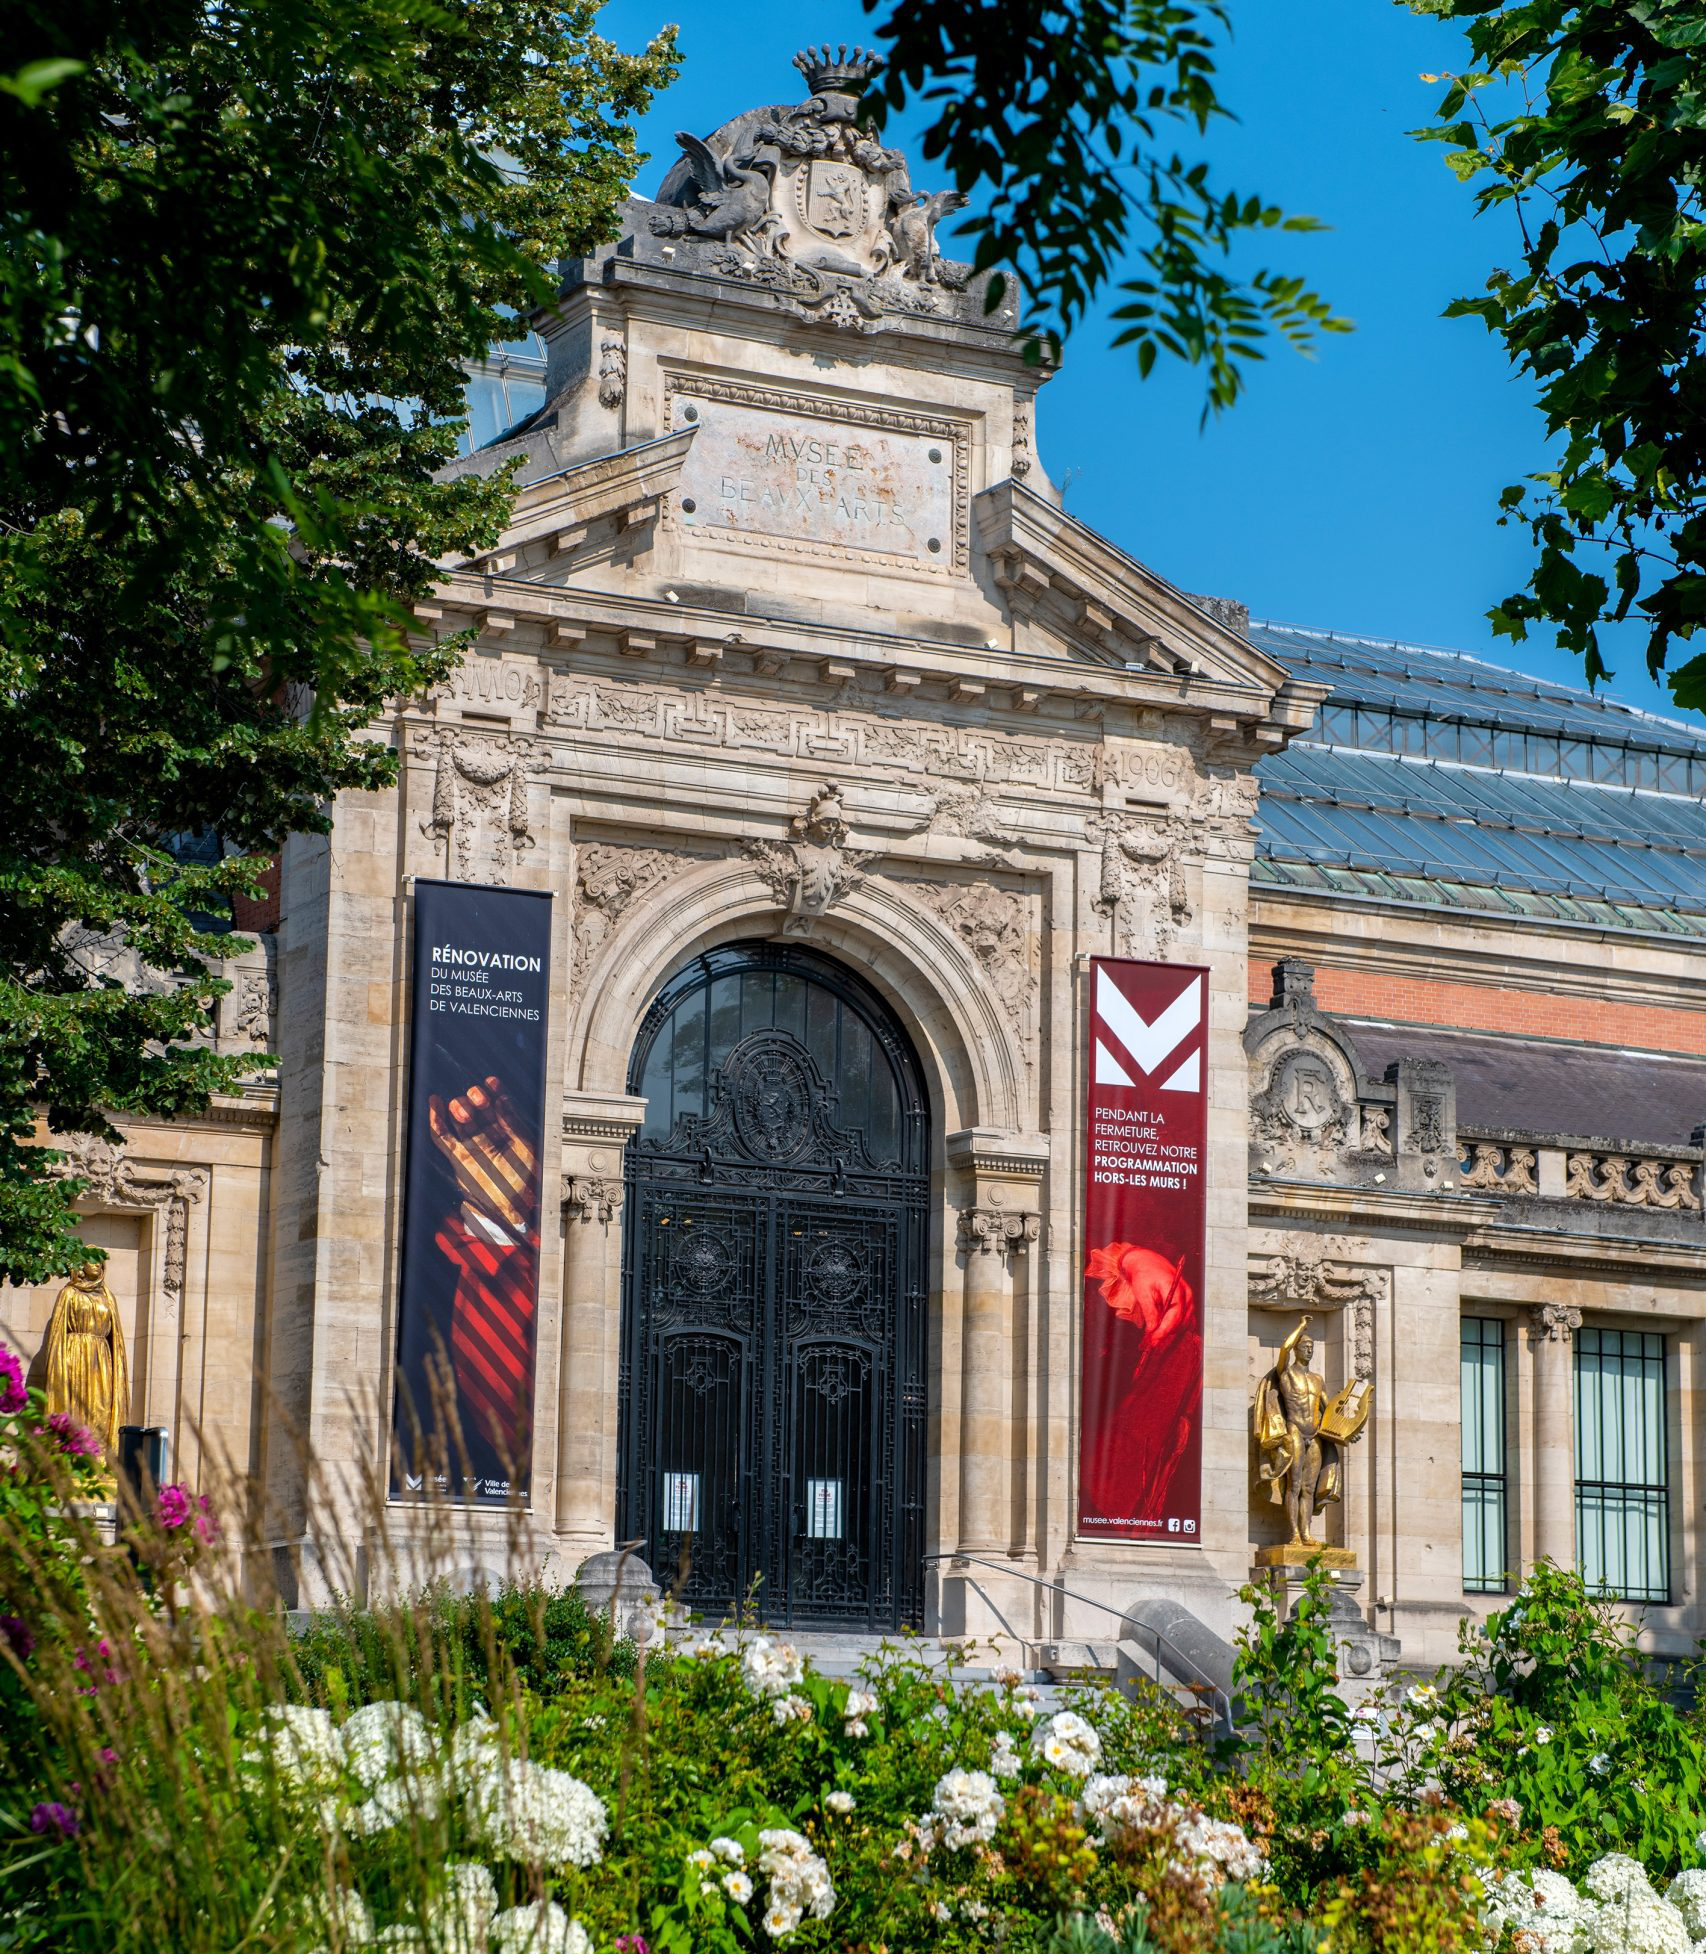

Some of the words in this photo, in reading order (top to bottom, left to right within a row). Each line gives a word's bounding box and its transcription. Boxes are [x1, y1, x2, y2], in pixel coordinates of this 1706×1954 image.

[796, 466, 832, 487] DES
[432, 943, 541, 972] RÉNOVATION
[431, 967, 448, 979] DU
[450, 969, 489, 984] MUSÉE
[430, 983, 452, 996] DES
[455, 986, 523, 1003] BEAUX-ARTS
[430, 999, 446, 1012] DE
[450, 1001, 540, 1021] VALENCIENNES
[1095, 1107, 1148, 1122] PENDANT
[1150, 1112, 1165, 1124] LA
[1095, 1123, 1160, 1140] FERMETURE,
[1094, 1139, 1158, 1156] RETROUVEZ
[1160, 1145, 1198, 1159] NOTRE
[1094, 1155, 1198, 1175] PROGRAMMATION
[1094, 1171, 1147, 1186] HORS-LES
[1149, 1176, 1180, 1189] MURS
[484, 1479, 500, 1488] Ville
[501, 1480, 510, 1488] de
